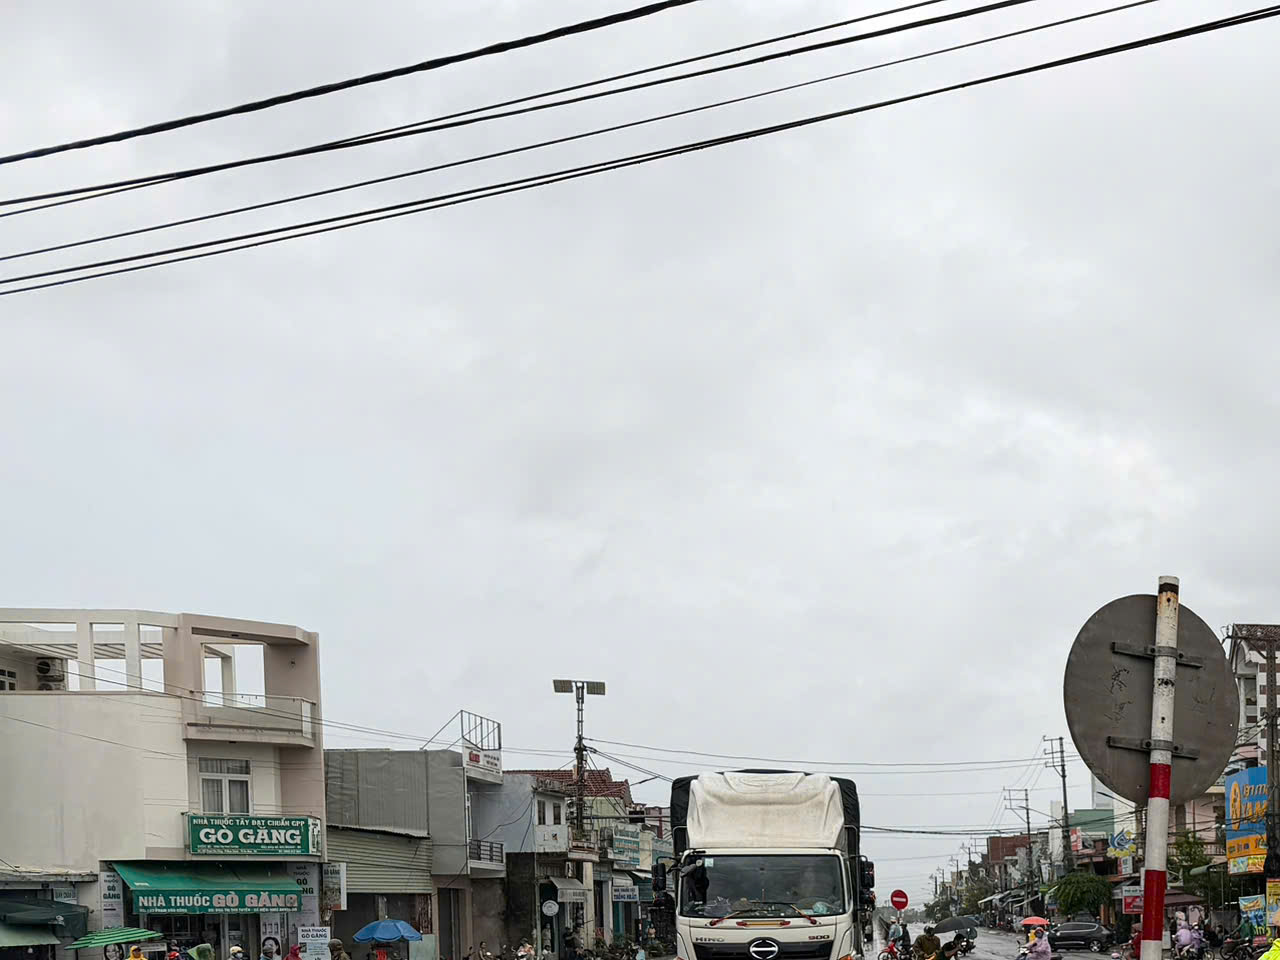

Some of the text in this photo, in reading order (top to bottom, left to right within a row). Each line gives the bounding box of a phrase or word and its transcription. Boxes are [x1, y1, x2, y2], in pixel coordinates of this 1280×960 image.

[193, 817, 208, 826] NHÀ
[291, 819, 305, 827] GPP
[199, 825, 302, 844] GÒ GĂNG
[302, 887, 314, 895] NG
[138, 891, 298, 907] NHÀ THUỐC GÒ GĂNG
